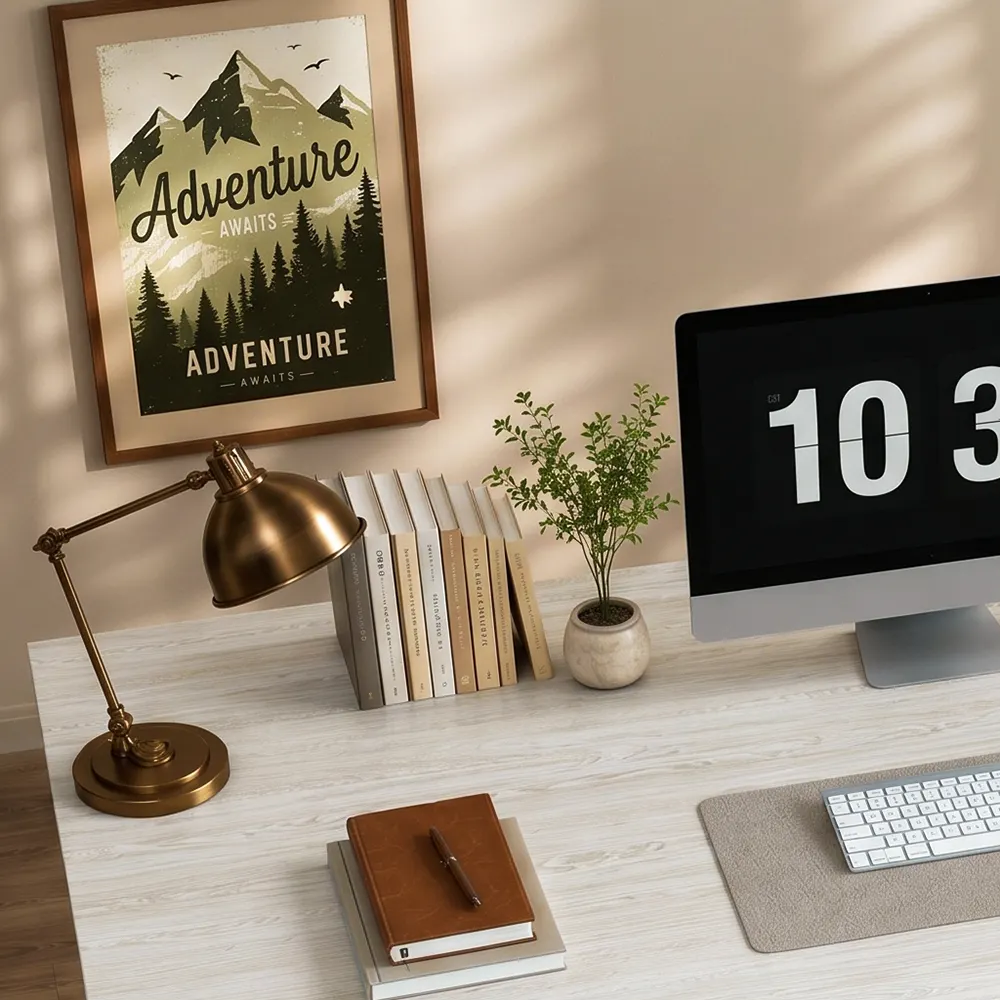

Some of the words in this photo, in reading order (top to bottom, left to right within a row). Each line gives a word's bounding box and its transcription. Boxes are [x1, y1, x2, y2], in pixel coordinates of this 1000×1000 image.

[131, 139, 359, 243] Adventure
[219, 212, 277, 239] AWAITS
[186, 328, 349, 378] ADVENTURE
[240, 371, 296, 388] AWAITS
[768, 379, 910, 504] 10
